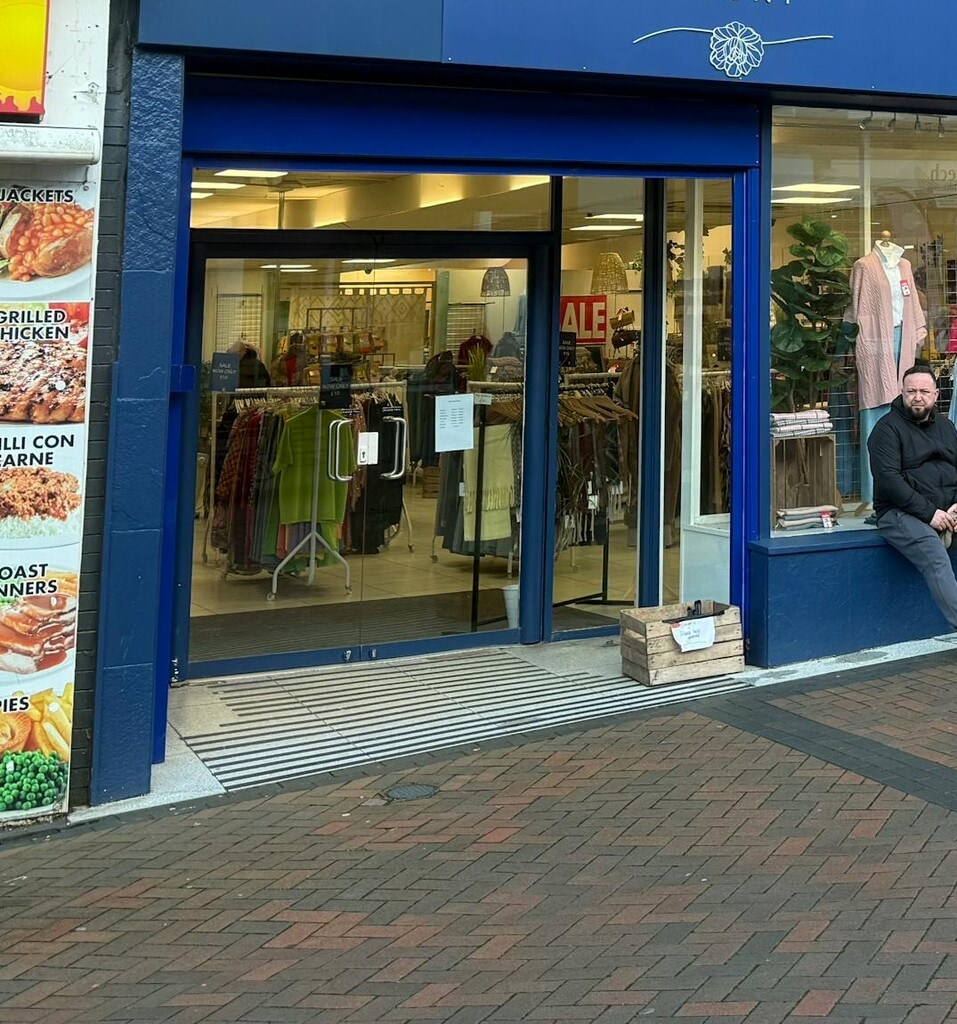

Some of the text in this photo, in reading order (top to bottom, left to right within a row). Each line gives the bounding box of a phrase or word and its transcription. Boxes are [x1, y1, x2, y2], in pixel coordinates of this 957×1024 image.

[0, 188, 74, 203] JACKETS
[0, 310, 66, 324] GRILLED
[562, 301, 605, 340] ALE
[32, 434, 75, 449] CON
[0, 451, 54, 467] ARNE
[0, 696, 29, 712] IES
